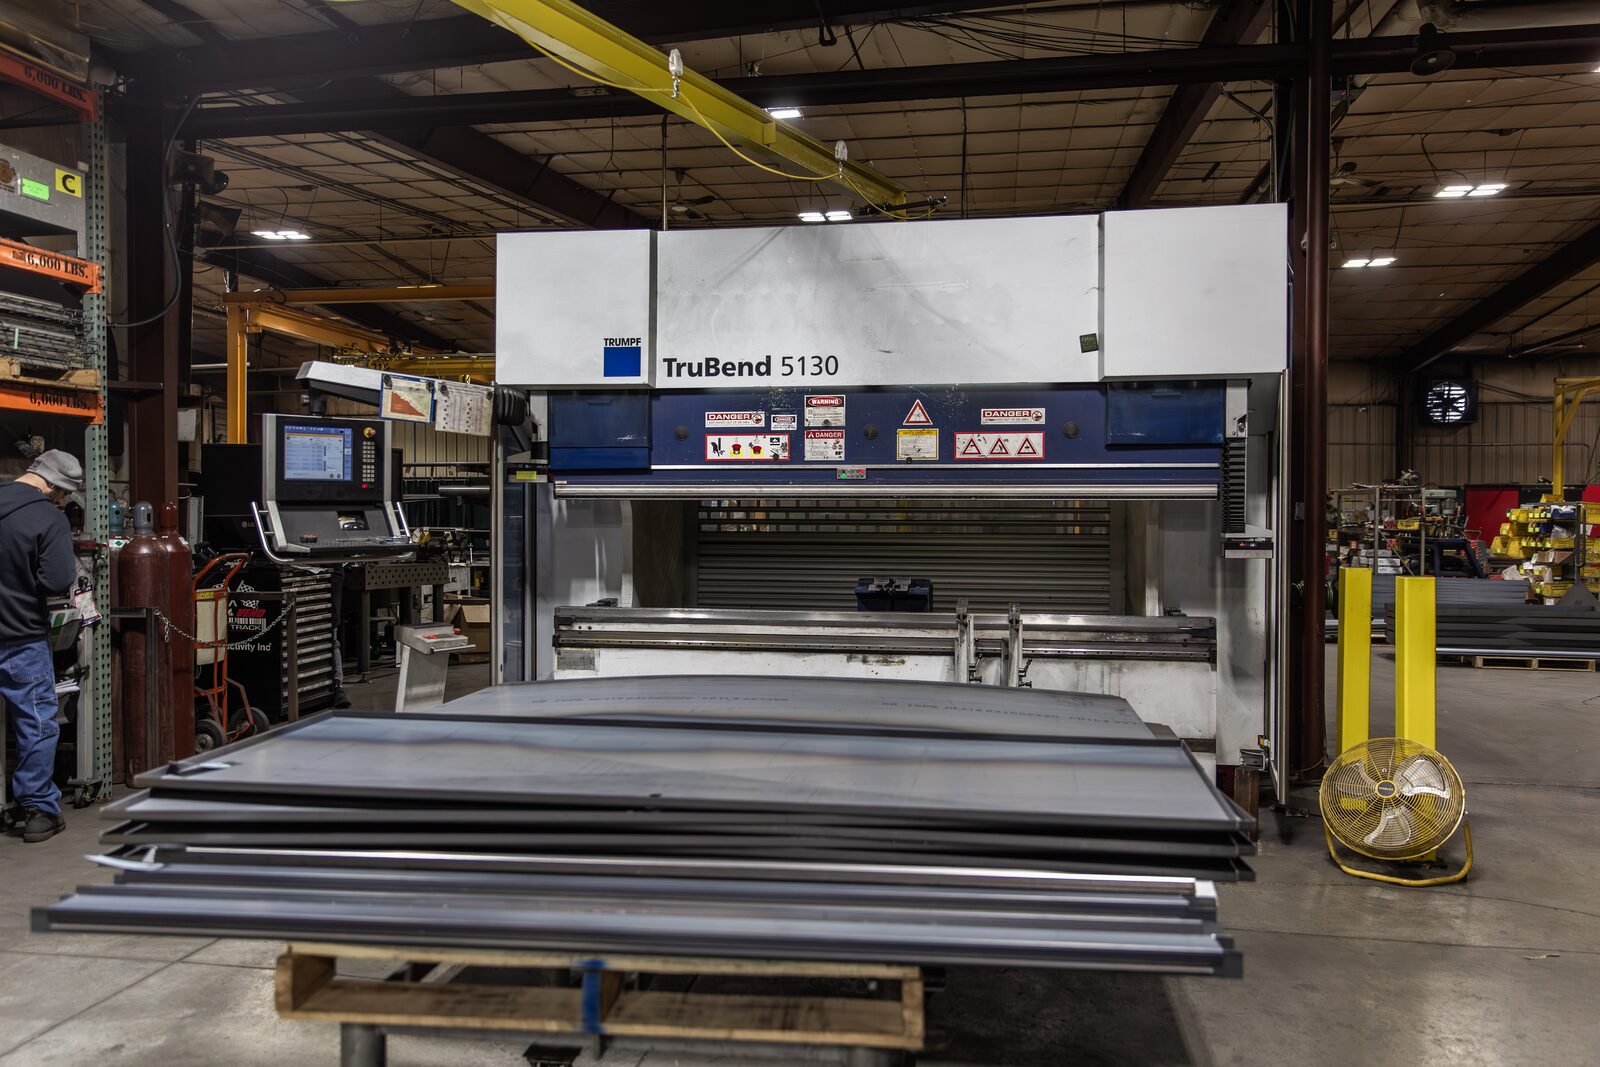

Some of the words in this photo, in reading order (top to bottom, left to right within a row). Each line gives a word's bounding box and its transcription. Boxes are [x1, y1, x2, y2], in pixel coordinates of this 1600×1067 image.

[24, 65, 58, 89] 6,000
[62, 174, 76, 194] C
[26, 252, 60, 271] 6,000
[64, 261, 88, 279] LBS.
[603, 337, 641, 347] TRUMPF
[662, 355, 772, 377] TruBend
[781, 355, 839, 376] 5130
